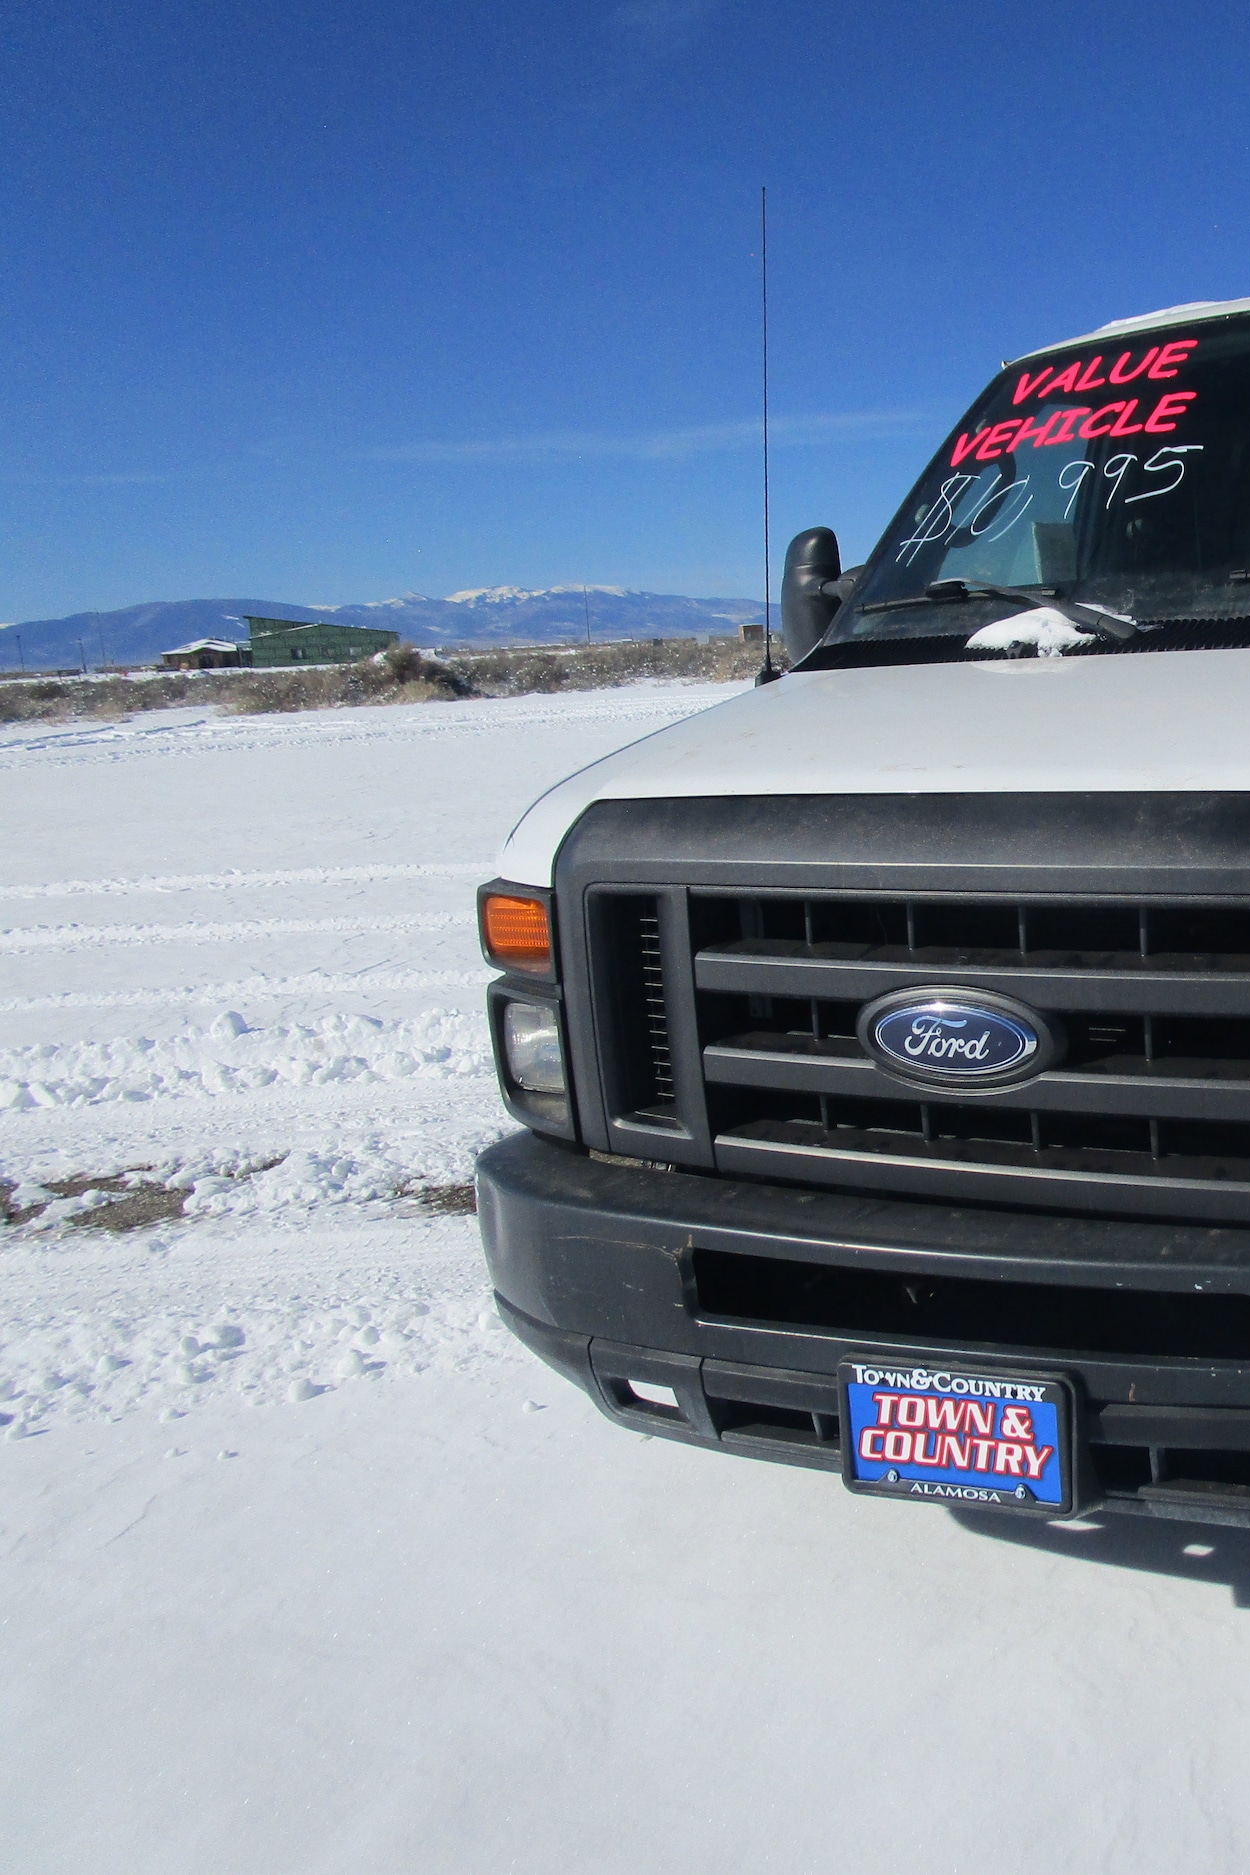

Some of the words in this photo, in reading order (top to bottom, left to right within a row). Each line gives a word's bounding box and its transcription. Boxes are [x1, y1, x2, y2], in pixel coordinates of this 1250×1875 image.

[1012, 339, 1199, 405] VALUE
[949, 391, 1198, 467] VEHICLE
[904, 1015, 990, 1060] Ford
[872, 1392, 996, 1436] TOWN
[1000, 1405, 1034, 1442] &
[859, 1426, 1053, 1480] COUNTRY
[910, 1482, 1001, 1503] ALAMOSA
